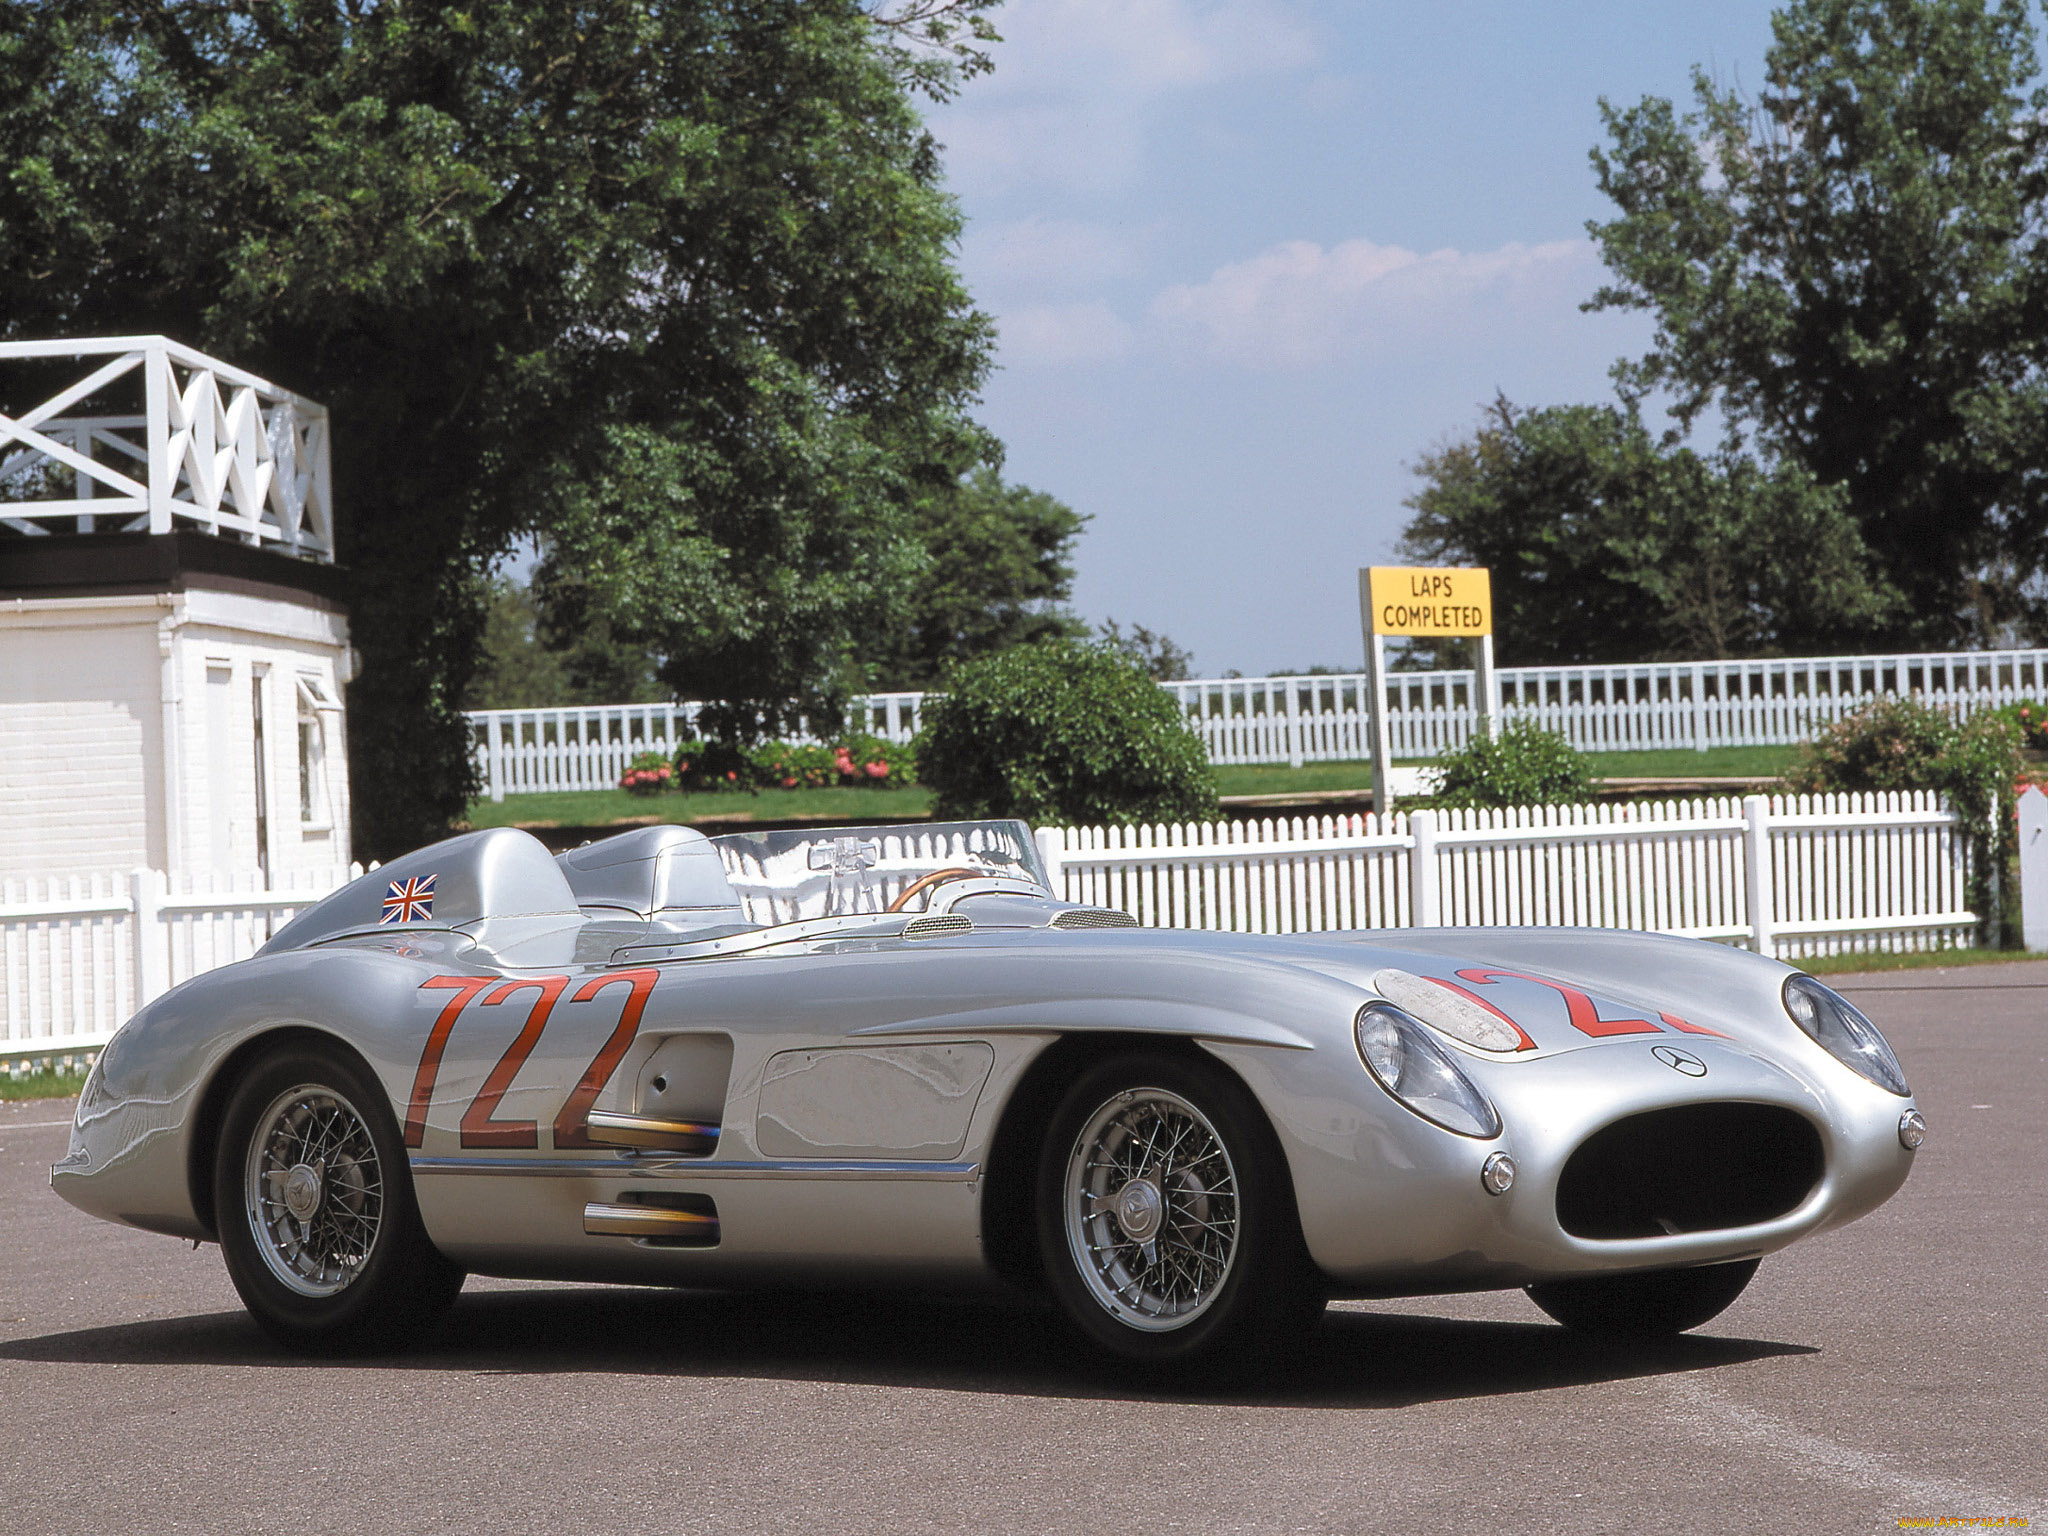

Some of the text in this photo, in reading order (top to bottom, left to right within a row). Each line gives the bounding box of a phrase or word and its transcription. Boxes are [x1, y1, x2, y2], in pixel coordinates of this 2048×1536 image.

[1411, 575, 1453, 597] LAPS
[1383, 605, 1483, 627] COMPLETED
[403, 967, 661, 1150] 722
